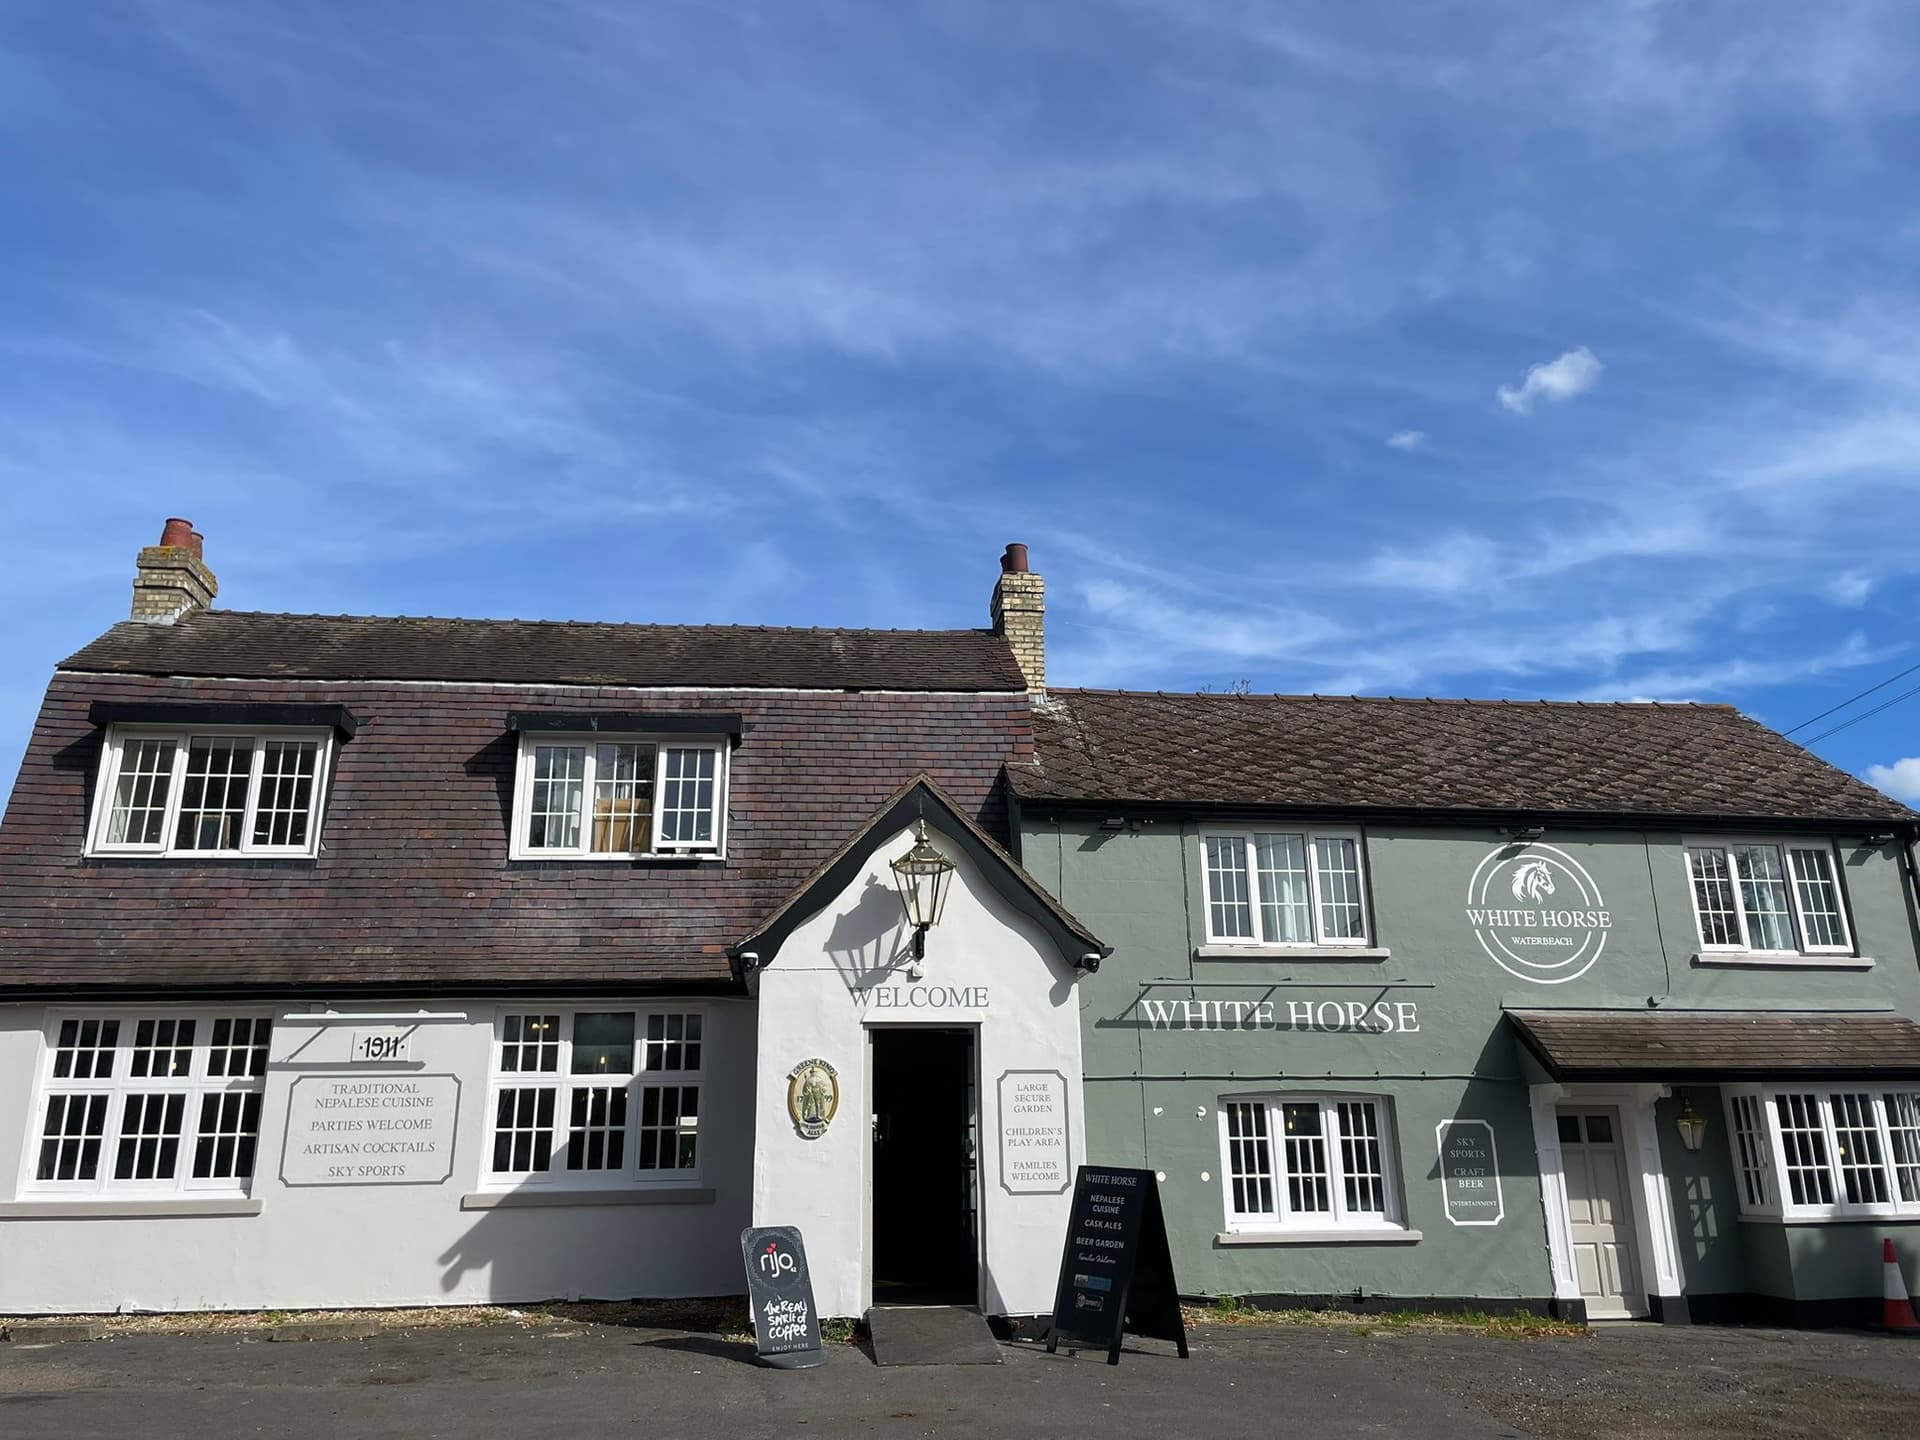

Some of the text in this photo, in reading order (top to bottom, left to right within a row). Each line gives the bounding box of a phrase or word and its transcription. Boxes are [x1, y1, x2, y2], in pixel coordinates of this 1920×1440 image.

[1466, 909, 1612, 929] WHITE HORSE
[1511, 936, 1573, 947] WATERBEACH
[850, 986, 989, 1008] WELCOME
[1139, 1000, 1420, 1033] WHITE HORSE
[363, 1036, 399, 1058] 1911
[793, 1059, 836, 1075] GREENE KING
[331, 1083, 420, 1095] TRADITIONAL
[1017, 1083, 1048, 1092] LARGE
[314, 1097, 434, 1109] NEPALESE CUISINE
[1014, 1094, 1051, 1103] SECURE
[1013, 1104, 1053, 1113] GARDEN
[311, 1119, 432, 1131] PARTIES WELCOME
[1005, 1127, 1063, 1136] CHILDREN'S
[1008, 1138, 1061, 1147] PLAY AREA
[1456, 1138, 1476, 1146] SKY
[303, 1142, 436, 1154] ARTISAN COCKTAILS
[1449, 1149, 1486, 1158] SPORTS
[328, 1165, 406, 1177] SKY SPORTS
[1013, 1161, 1057, 1170] FAMILIES
[1011, 1171, 1060, 1181] WELCOME
[1454, 1167, 1486, 1177] CRAFT
[1085, 1173, 1138, 1187] WHITE HORSE
[1458, 1179, 1484, 1188] BEER
[1090, 1194, 1126, 1205] NEPALESE
[1092, 1204, 1120, 1215] CUISINE
[1084, 1219, 1122, 1230] CASK ALES
[1076, 1236, 1125, 1249] BEER GARDEN
[760, 1243, 794, 1278] rijo
